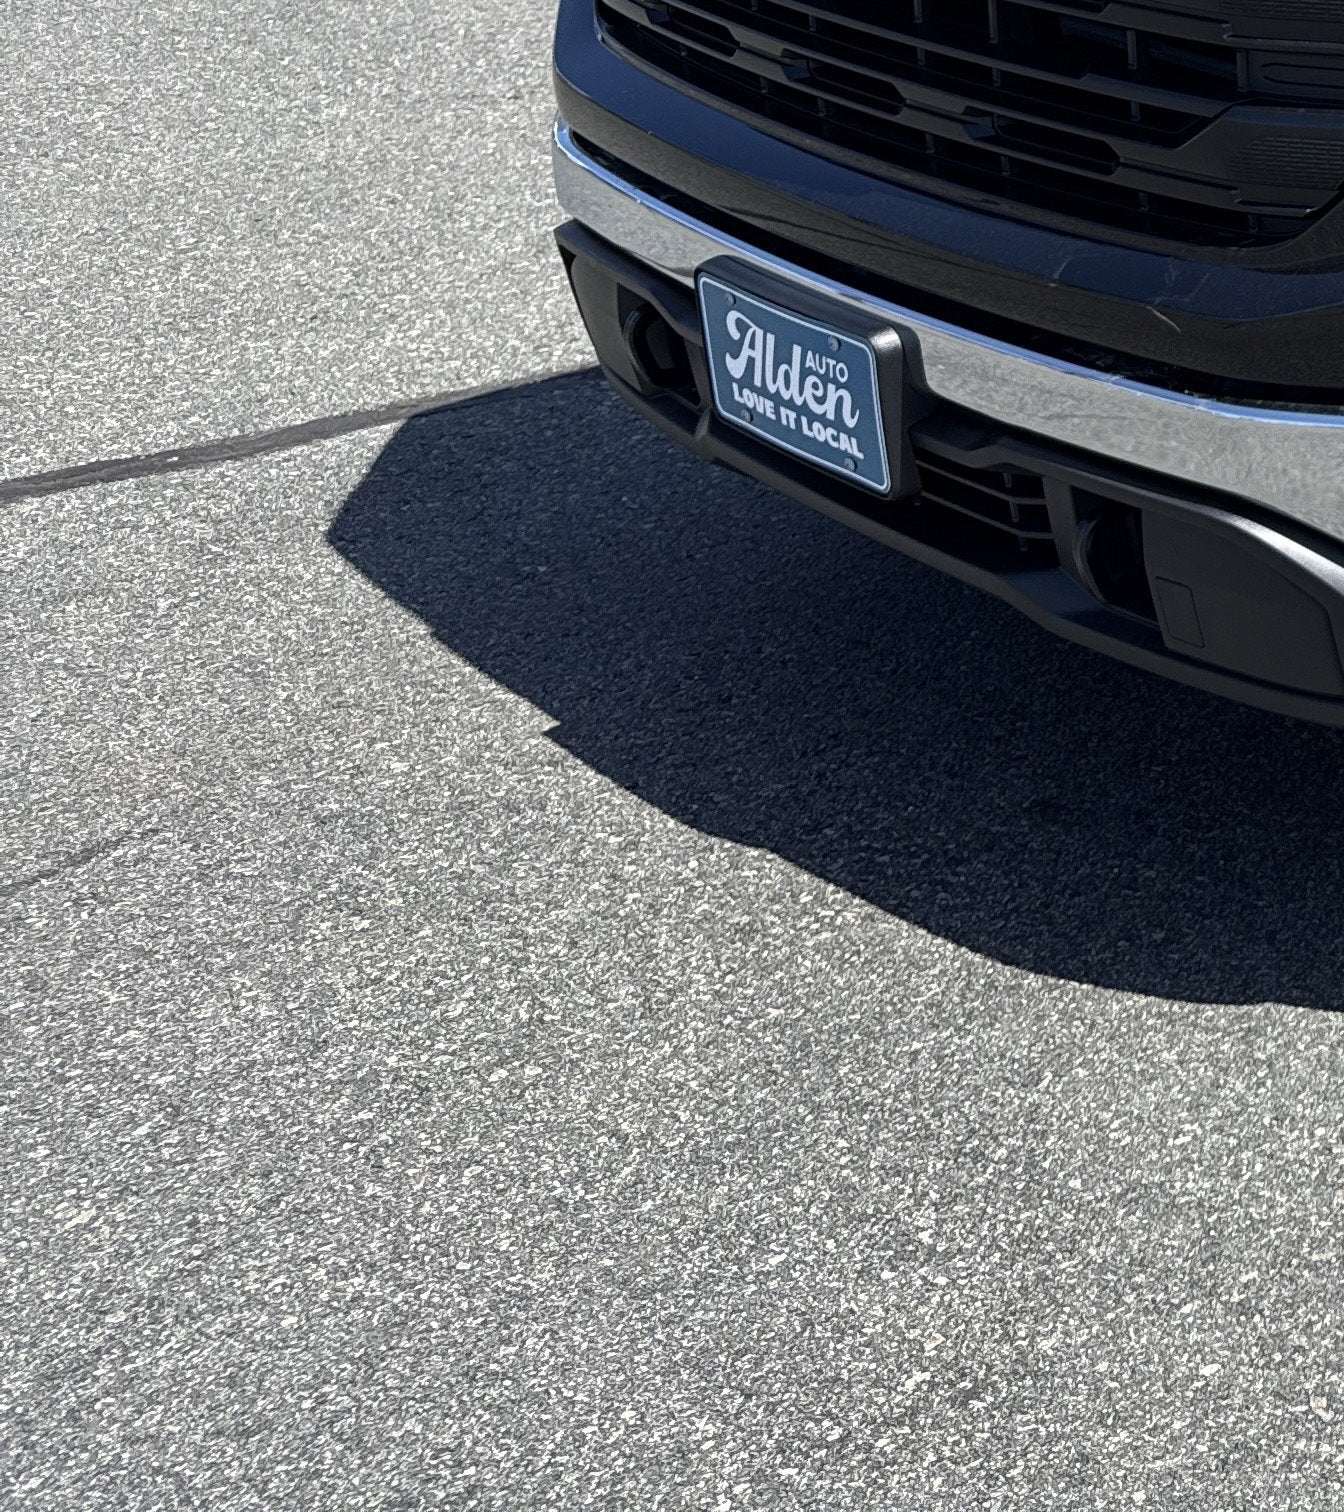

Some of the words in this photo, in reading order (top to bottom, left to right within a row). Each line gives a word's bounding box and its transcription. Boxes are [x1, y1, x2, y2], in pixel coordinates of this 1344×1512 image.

[725, 309, 859, 428] Alden
[805, 350, 848, 383] AUTO
[732, 381, 776, 420] LOVE
[780, 406, 796, 430] IT
[801, 415, 864, 459] LOCAL
